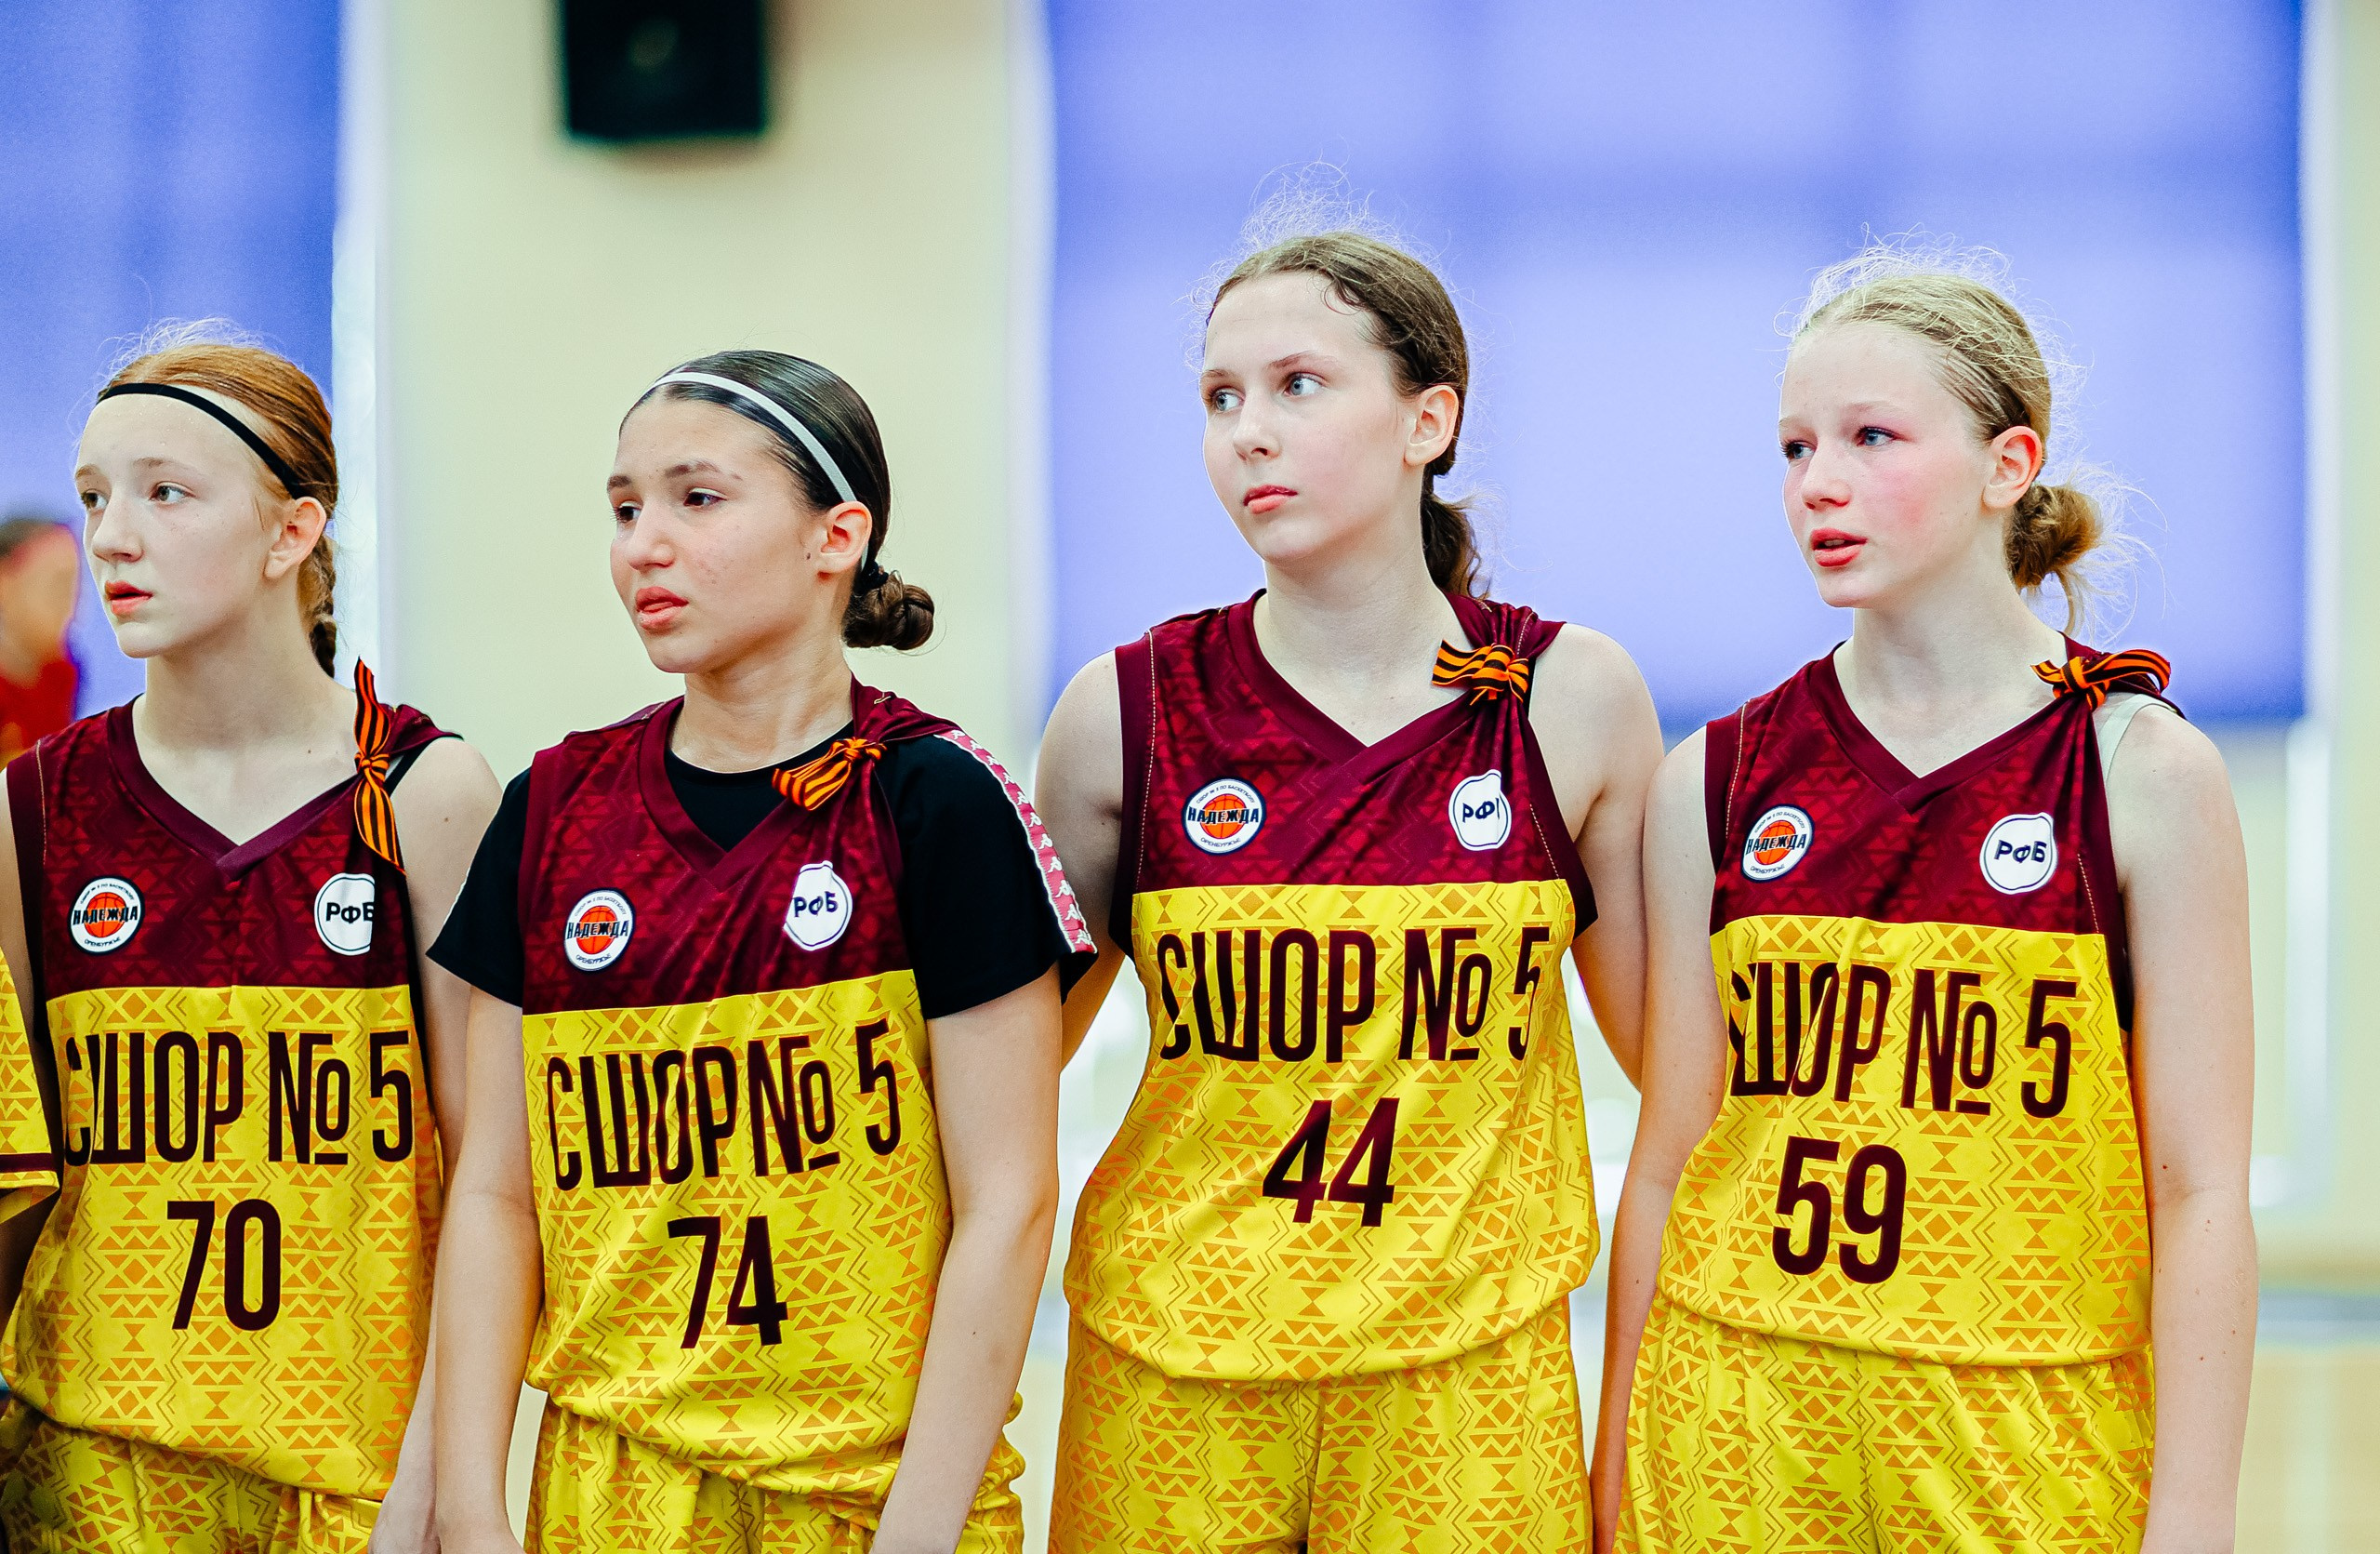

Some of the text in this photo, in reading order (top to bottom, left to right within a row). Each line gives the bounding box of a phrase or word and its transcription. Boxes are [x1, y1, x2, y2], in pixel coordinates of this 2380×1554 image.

[1187, 805, 1260, 825] НАДЕЖДА
[1461, 797, 1501, 824] РФ
[1745, 833, 1807, 856] НАДЕЖДА
[1993, 839, 2047, 866] РФБ
[73, 905, 139, 925] НАДЕЖДА
[566, 920, 630, 940] НАДЕЖДА
[793, 891, 840, 918] РФБ
[1157, 926, 1550, 1064] СШОР № 5
[1901, 968, 1998, 1116] №
[2020, 978, 2077, 1120] 5
[268, 1031, 351, 1165] №
[369, 1030, 414, 1163] 5
[546, 1017, 902, 1191] СШОР № 5
[1262, 1096, 1400, 1228] 44
[166, 1198, 282, 1332] 70
[1771, 1135, 1908, 1285] 59
[667, 1215, 789, 1350] 74
